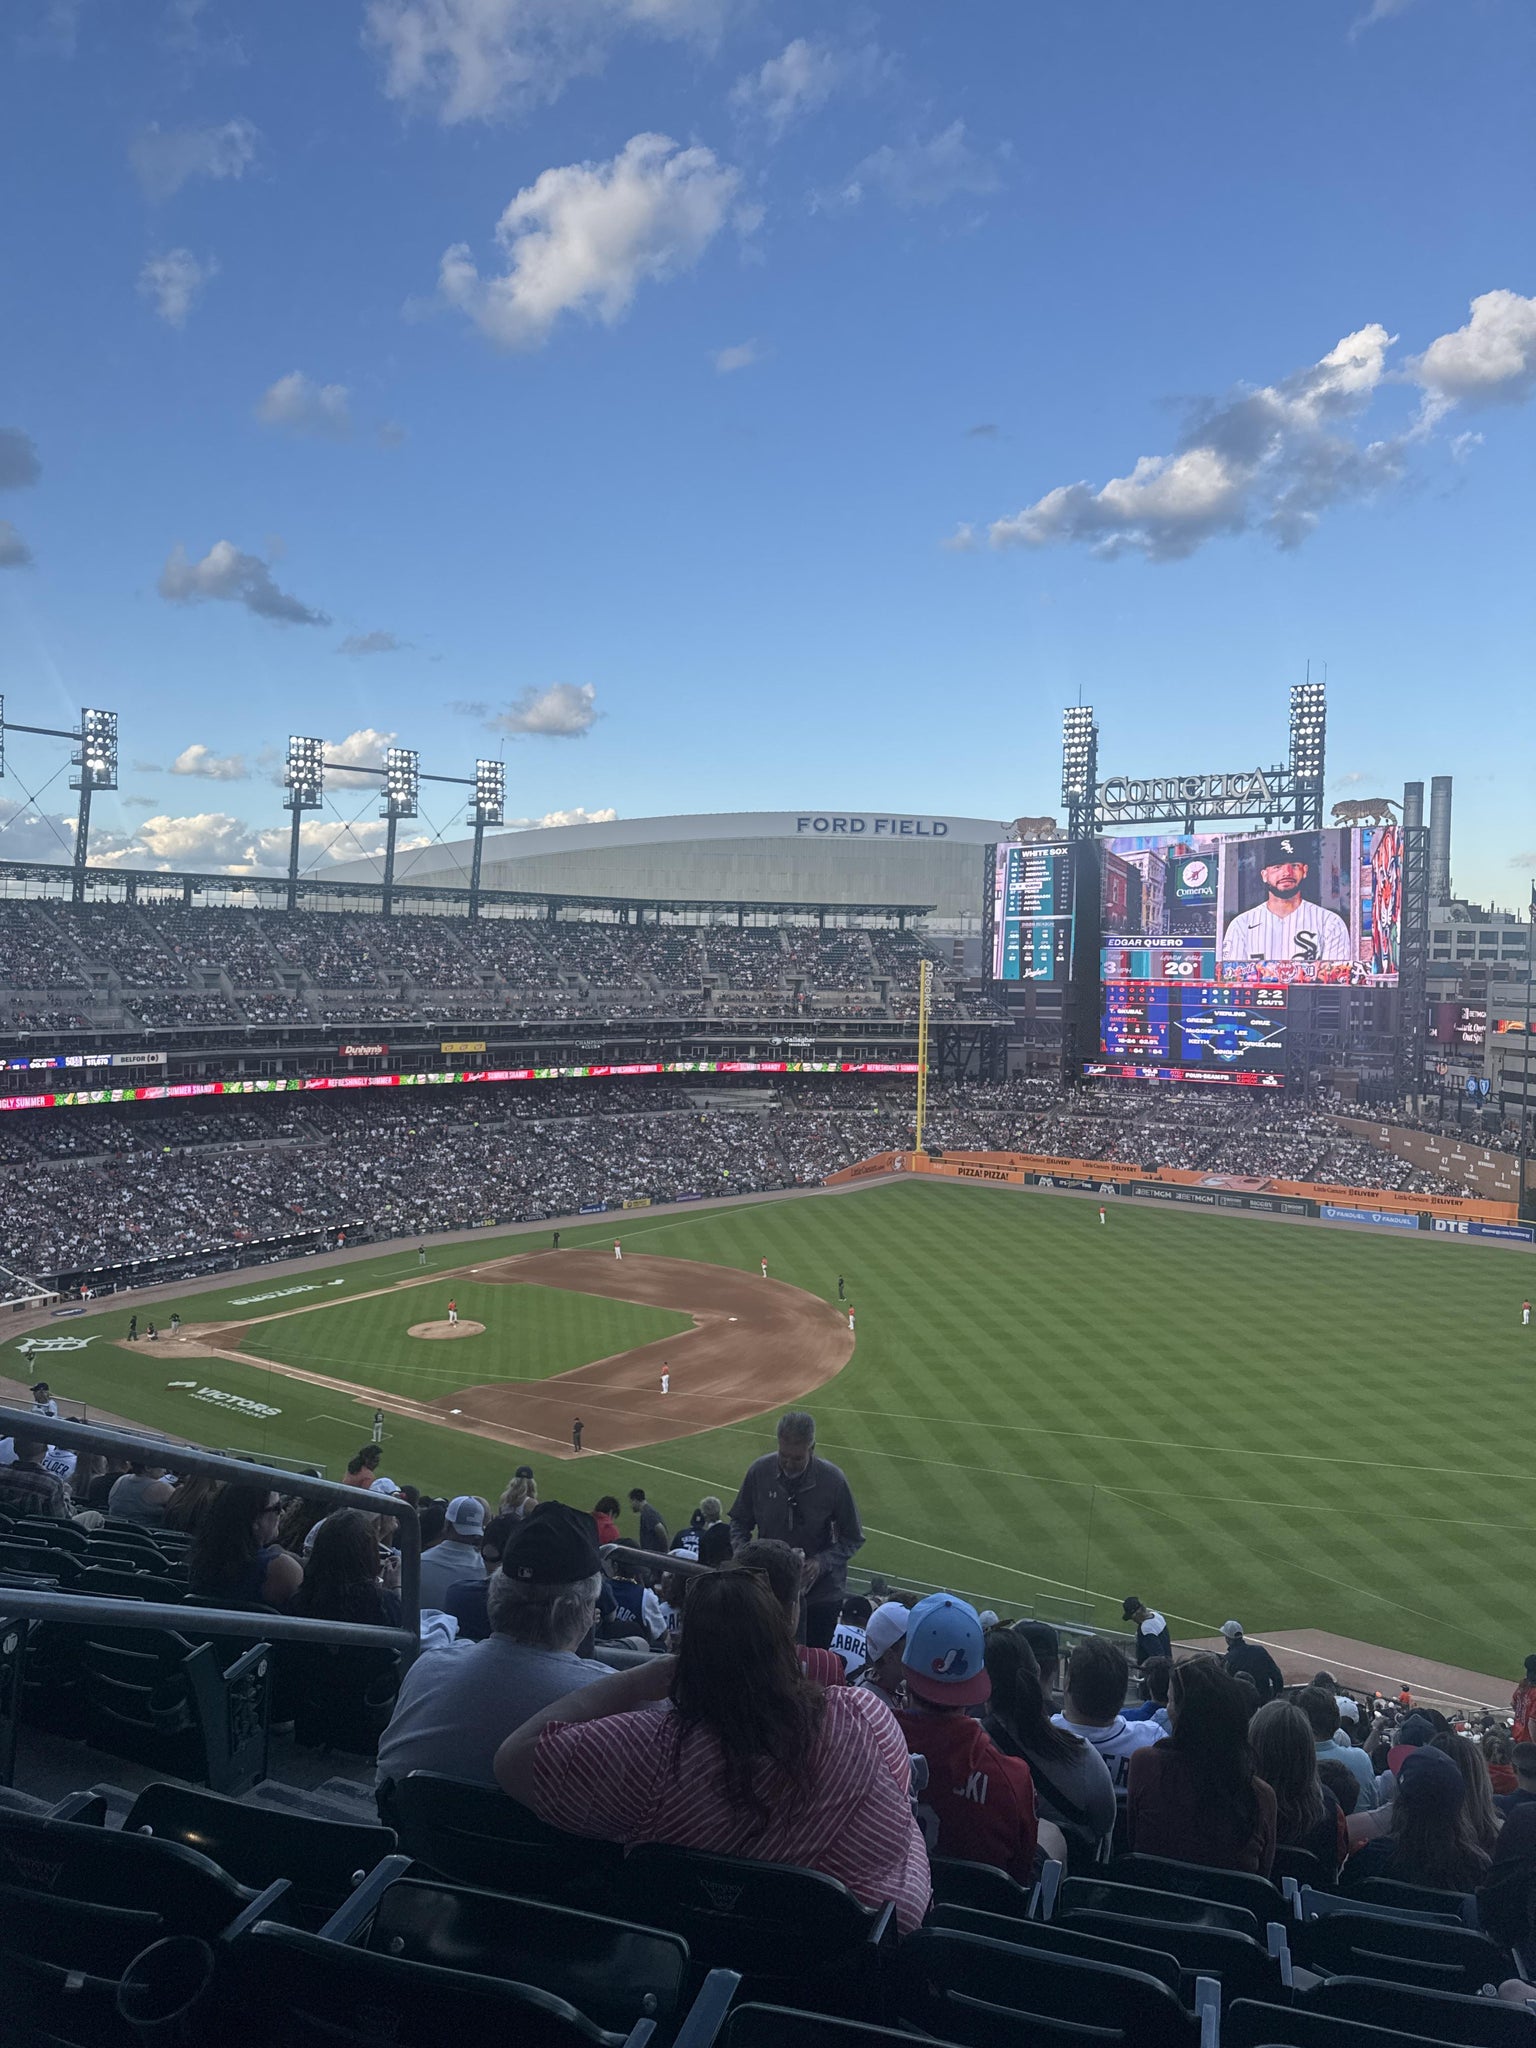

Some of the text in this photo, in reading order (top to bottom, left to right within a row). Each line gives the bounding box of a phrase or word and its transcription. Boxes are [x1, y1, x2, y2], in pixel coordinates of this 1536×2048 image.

[1145, 802, 1225, 816] PARK
[797, 818, 948, 836] FORD FIELD
[1022, 850, 1049, 858] WHITE
[1144, 938, 1183, 947] QUERO
[1258, 989, 1283, 998] 2-2
[783, 1036, 816, 1045] Gallagher
[166, 1085, 191, 1096] SUMMER
[192, 1083, 215, 1095] SHANDY
[15, 1096, 45, 1108] SUMMER
[958, 1167, 1009, 1181] PIZZA! PIZZA!
[1140, 1189, 1172, 1199] BETMGM
[1181, 1193, 1214, 1203] BETMGM
[1394, 1193, 1407, 1201] Little
[1407, 1195, 1429, 1203] Caesars
[472, 1218, 496, 1228] bet365
[1336, 1212, 1412, 1225] FANDUEL FANDUEL
[1435, 1220, 1469, 1233] DTE
[197, 1387, 283, 1416] VICTORS
